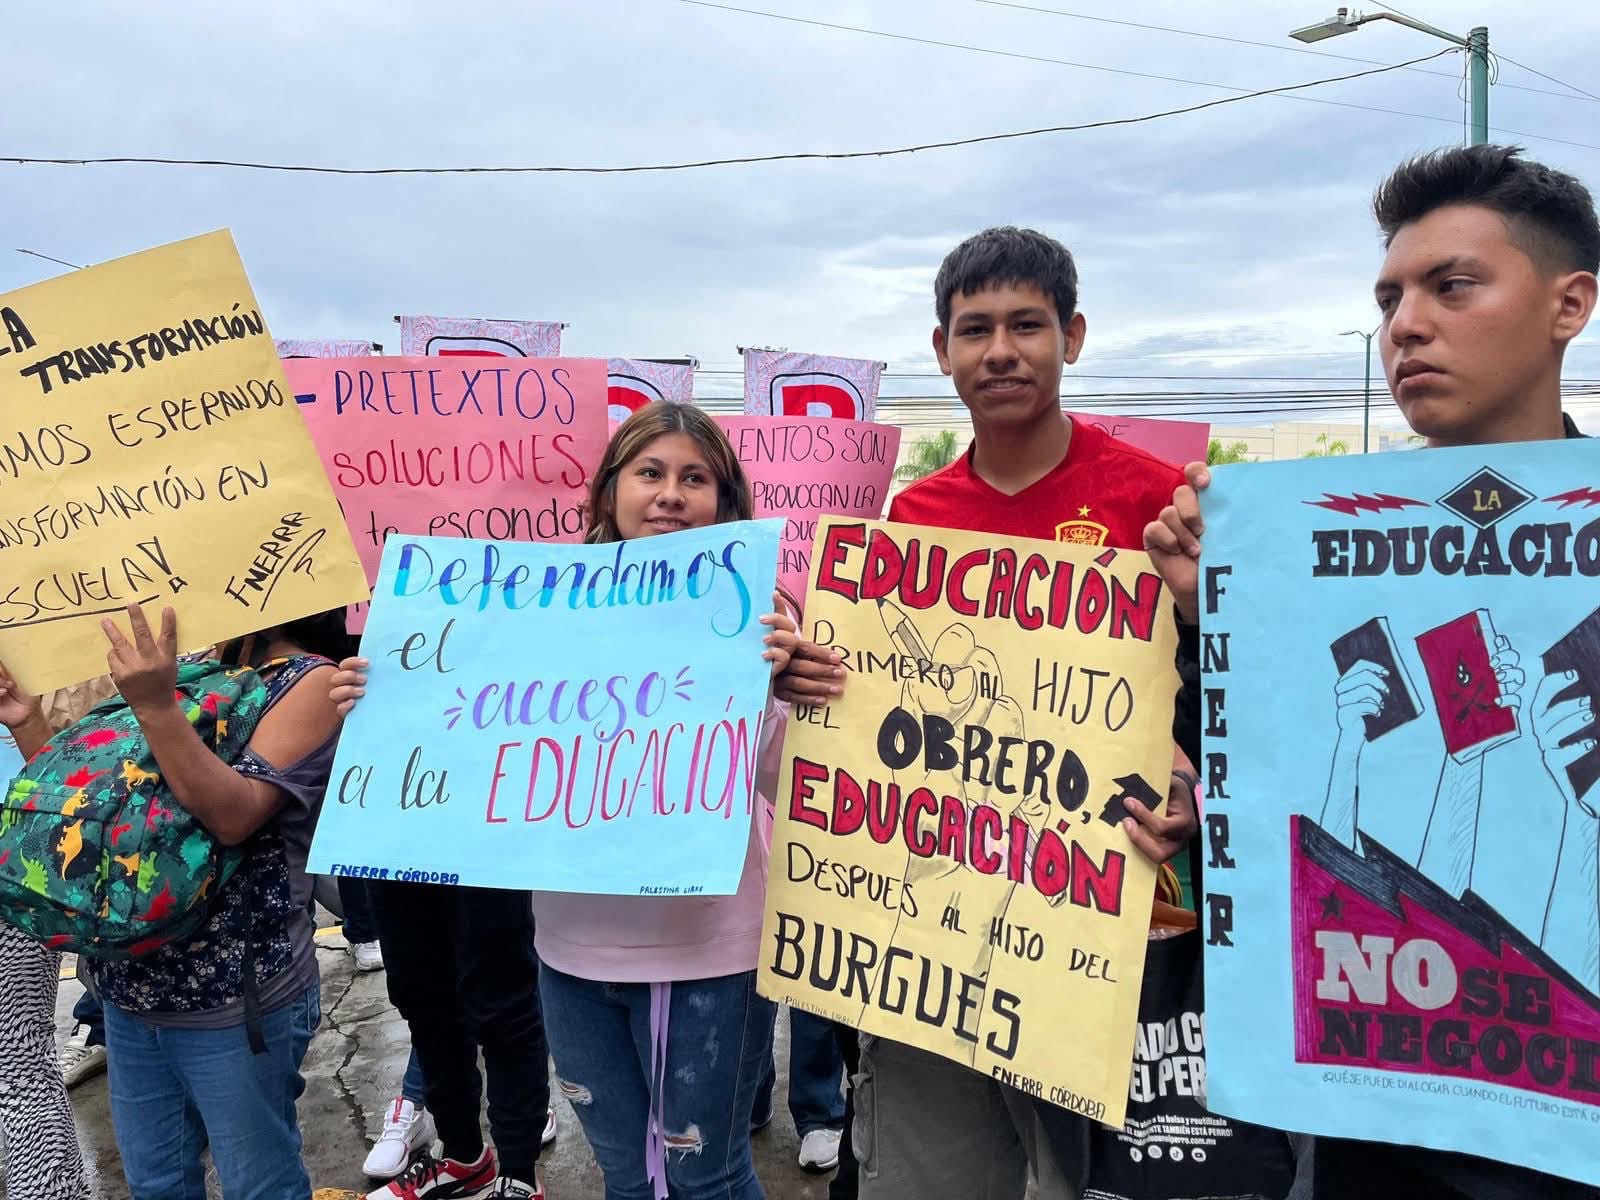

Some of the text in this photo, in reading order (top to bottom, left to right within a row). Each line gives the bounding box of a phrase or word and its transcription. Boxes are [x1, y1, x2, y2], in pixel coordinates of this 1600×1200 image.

[0, 306, 37, 357] A
[20, 303, 264, 394] TRANSFORMACIÓN
[0, 379, 284, 478] MOS ESPERANDO
[335, 368, 574, 424] PRETEXTOS
[334, 434, 586, 489] SOLUCIONES
[726, 425, 834, 463] ENTOS
[218, 461, 269, 501] EN
[752, 481, 875, 510] PROVOCAN LA
[1473, 488, 1502, 512] LA
[393, 540, 752, 638] Defendamos
[816, 523, 1163, 642] EDUCACIÓN
[388, 619, 456, 673] el
[472, 671, 667, 743] acceso
[980, 672, 1009, 701] AL
[1032, 657, 1134, 732] HIJO
[338, 696, 763, 828] a la EDUCACIÓN
[795, 704, 1091, 823] DEL OBRERO,
[1201, 565, 1236, 948] FNERRR
[789, 757, 1126, 916] EDUCACIÓN
[330, 864, 460, 885] FNERRR CÓRDOBA
[940, 906, 967, 934] AL
[989, 917, 1044, 961] HIJO
[1068, 948, 1117, 983] DEL
[1315, 930, 1552, 1026] NO SE
[770, 911, 1021, 1061] BURGUÉS
[1181, 1011, 1206, 1053] C
[992, 1065, 1043, 1098] FNERRR
[1363, 1076, 1396, 1089] PUEDE
[1398, 1079, 1450, 1095] DIALOGAR
[1452, 1084, 1498, 1102] CUANDO
